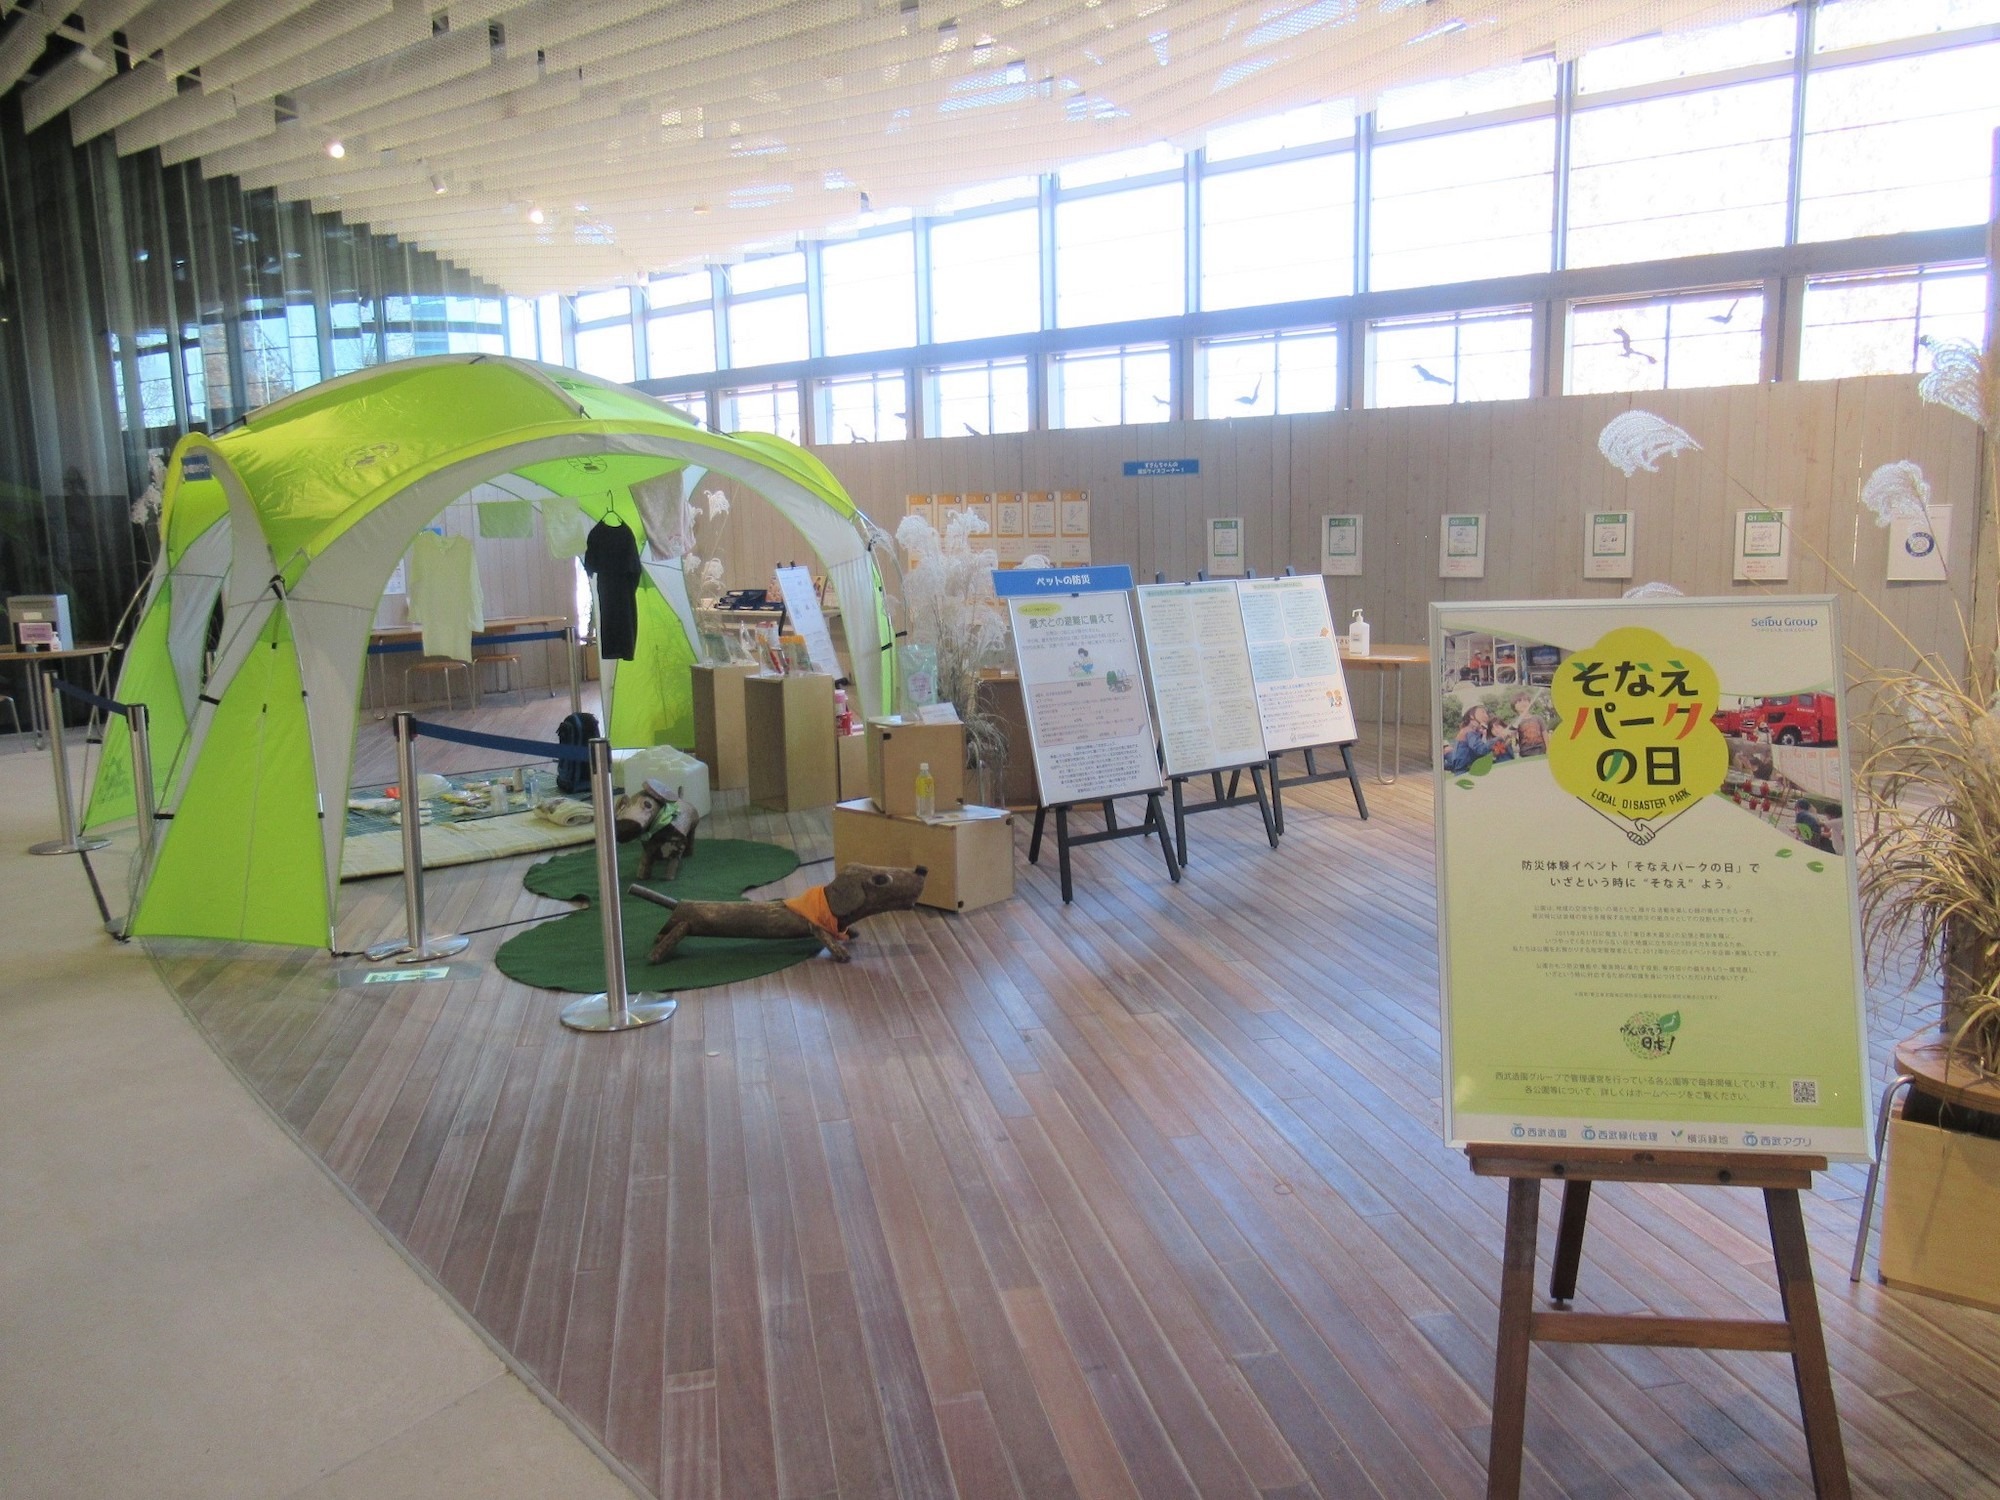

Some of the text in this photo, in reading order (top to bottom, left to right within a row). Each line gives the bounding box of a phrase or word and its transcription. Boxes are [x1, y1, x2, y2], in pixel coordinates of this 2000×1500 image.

[1036, 574, 1091, 586] ペットの防災
[1029, 613, 1114, 629] 愛犬との避難に備えて
[1751, 616, 1818, 627] Seibu Group
[1571, 660, 1698, 698] そなえ
[1569, 702, 1703, 741] パーク
[1596, 747, 1681, 786] の日
[1591, 788, 1692, 811] LOCAL DISASTER PARK
[1521, 860, 1760, 874] 防災体験イベント「そなえパークの日」で
[1495, 1071, 1780, 1089] 西武造園グループで管理運営を行っている各公園等で毎年開催しています。
[1525, 1086, 1750, 1102] 各公園等について、詳しくはホームページをご覧ください。
[1527, 1127, 1567, 1139] 西武造園
[1598, 1130, 1658, 1142] 西武緑化管理
[1687, 1134, 1729, 1145] 横浜緑地
[1760, 1136, 1812, 1147] 西武アグリ
